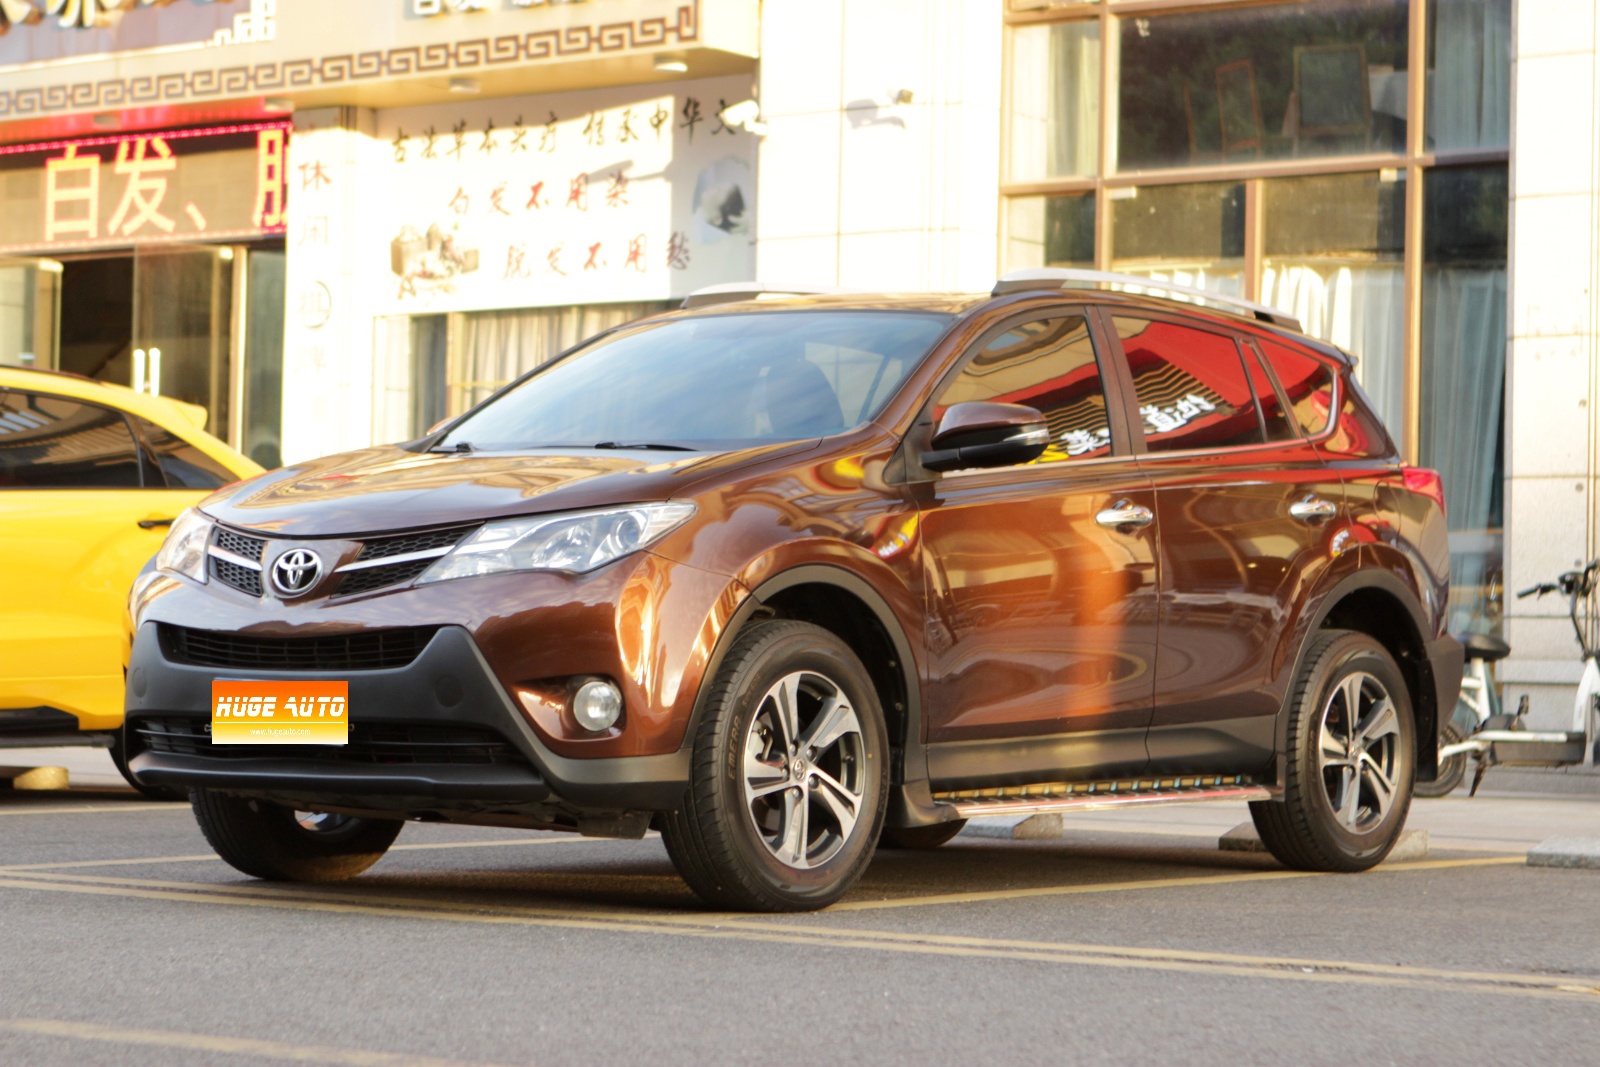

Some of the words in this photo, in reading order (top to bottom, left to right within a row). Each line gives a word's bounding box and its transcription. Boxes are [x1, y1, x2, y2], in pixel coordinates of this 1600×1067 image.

[582, 97, 767, 147] 传承中华文
[448, 169, 631, 216] 白发不用染
[502, 231, 691, 280] 脱发不用愁
